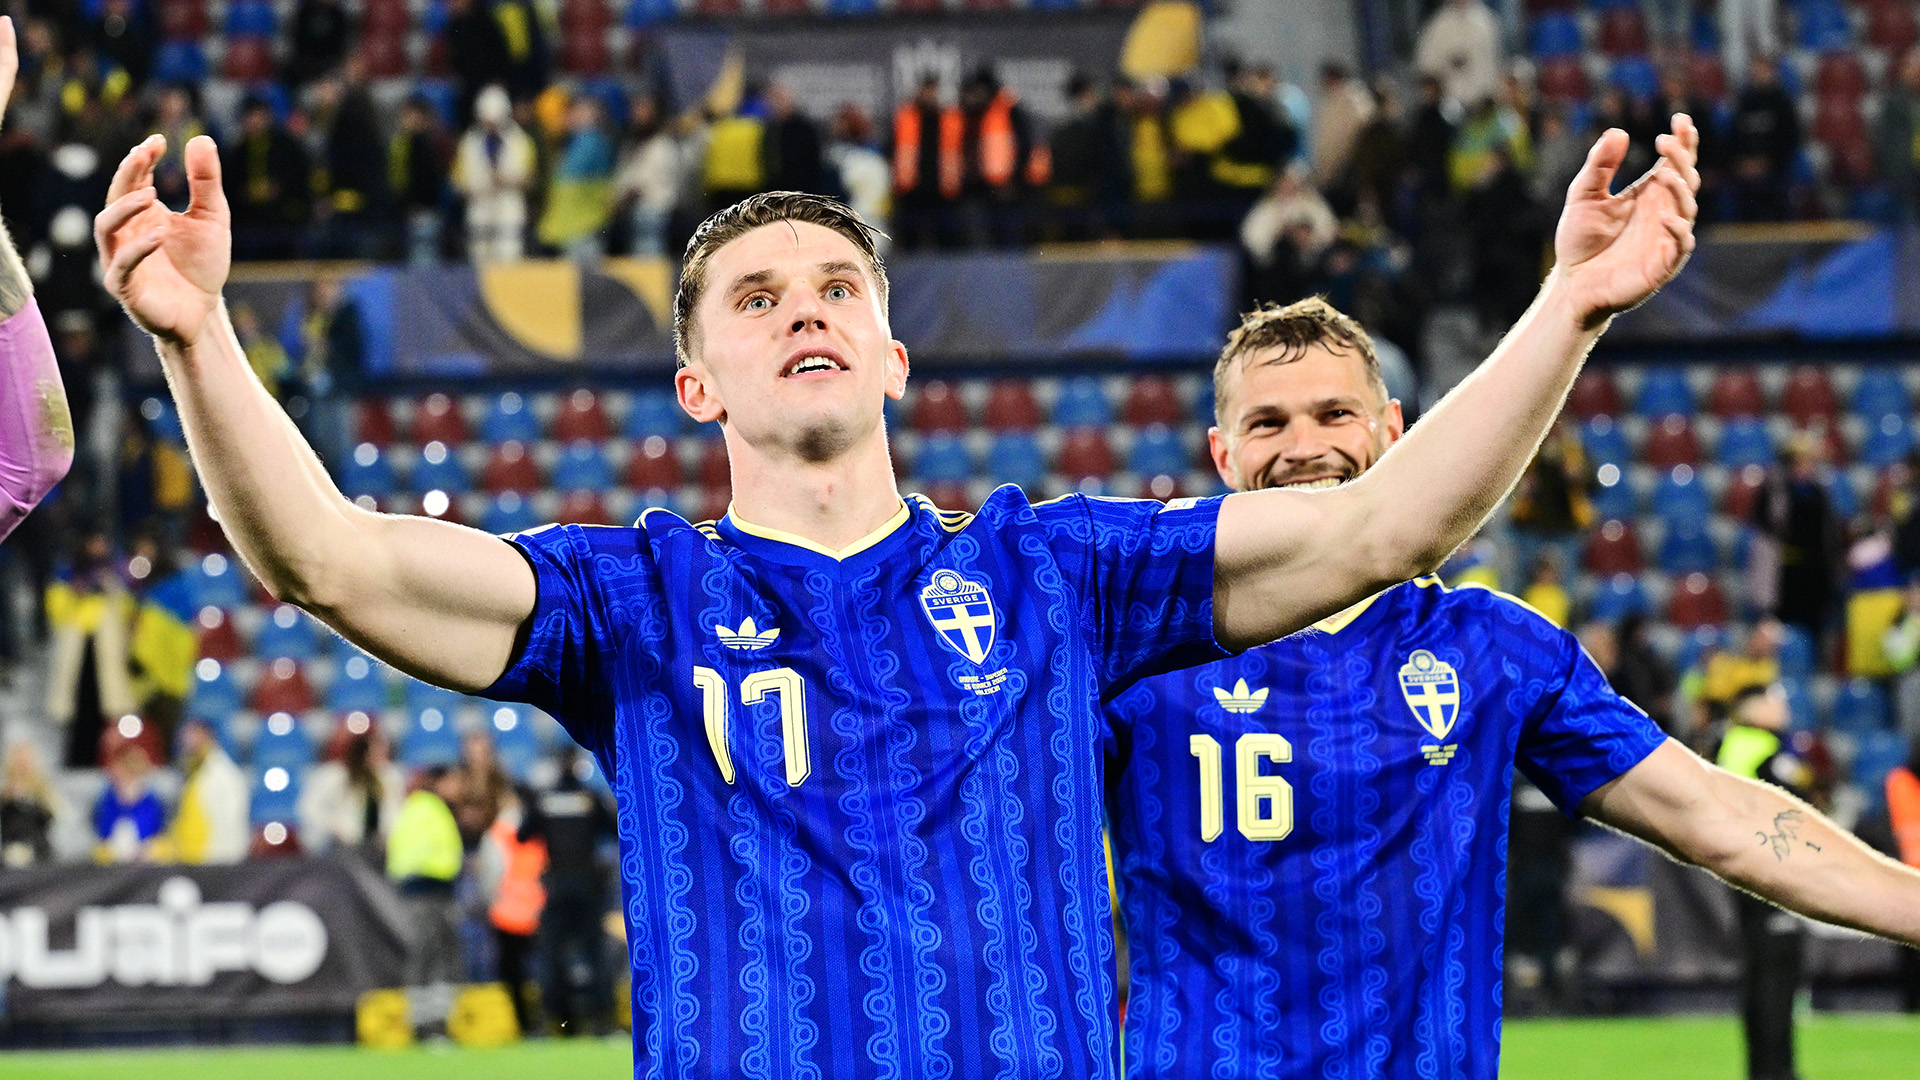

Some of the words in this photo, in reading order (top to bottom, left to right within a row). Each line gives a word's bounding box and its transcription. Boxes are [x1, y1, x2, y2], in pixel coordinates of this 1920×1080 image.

[932, 594, 979, 606] SVERIGE
[693, 665, 811, 787] 17
[1189, 733, 1294, 842] 16
